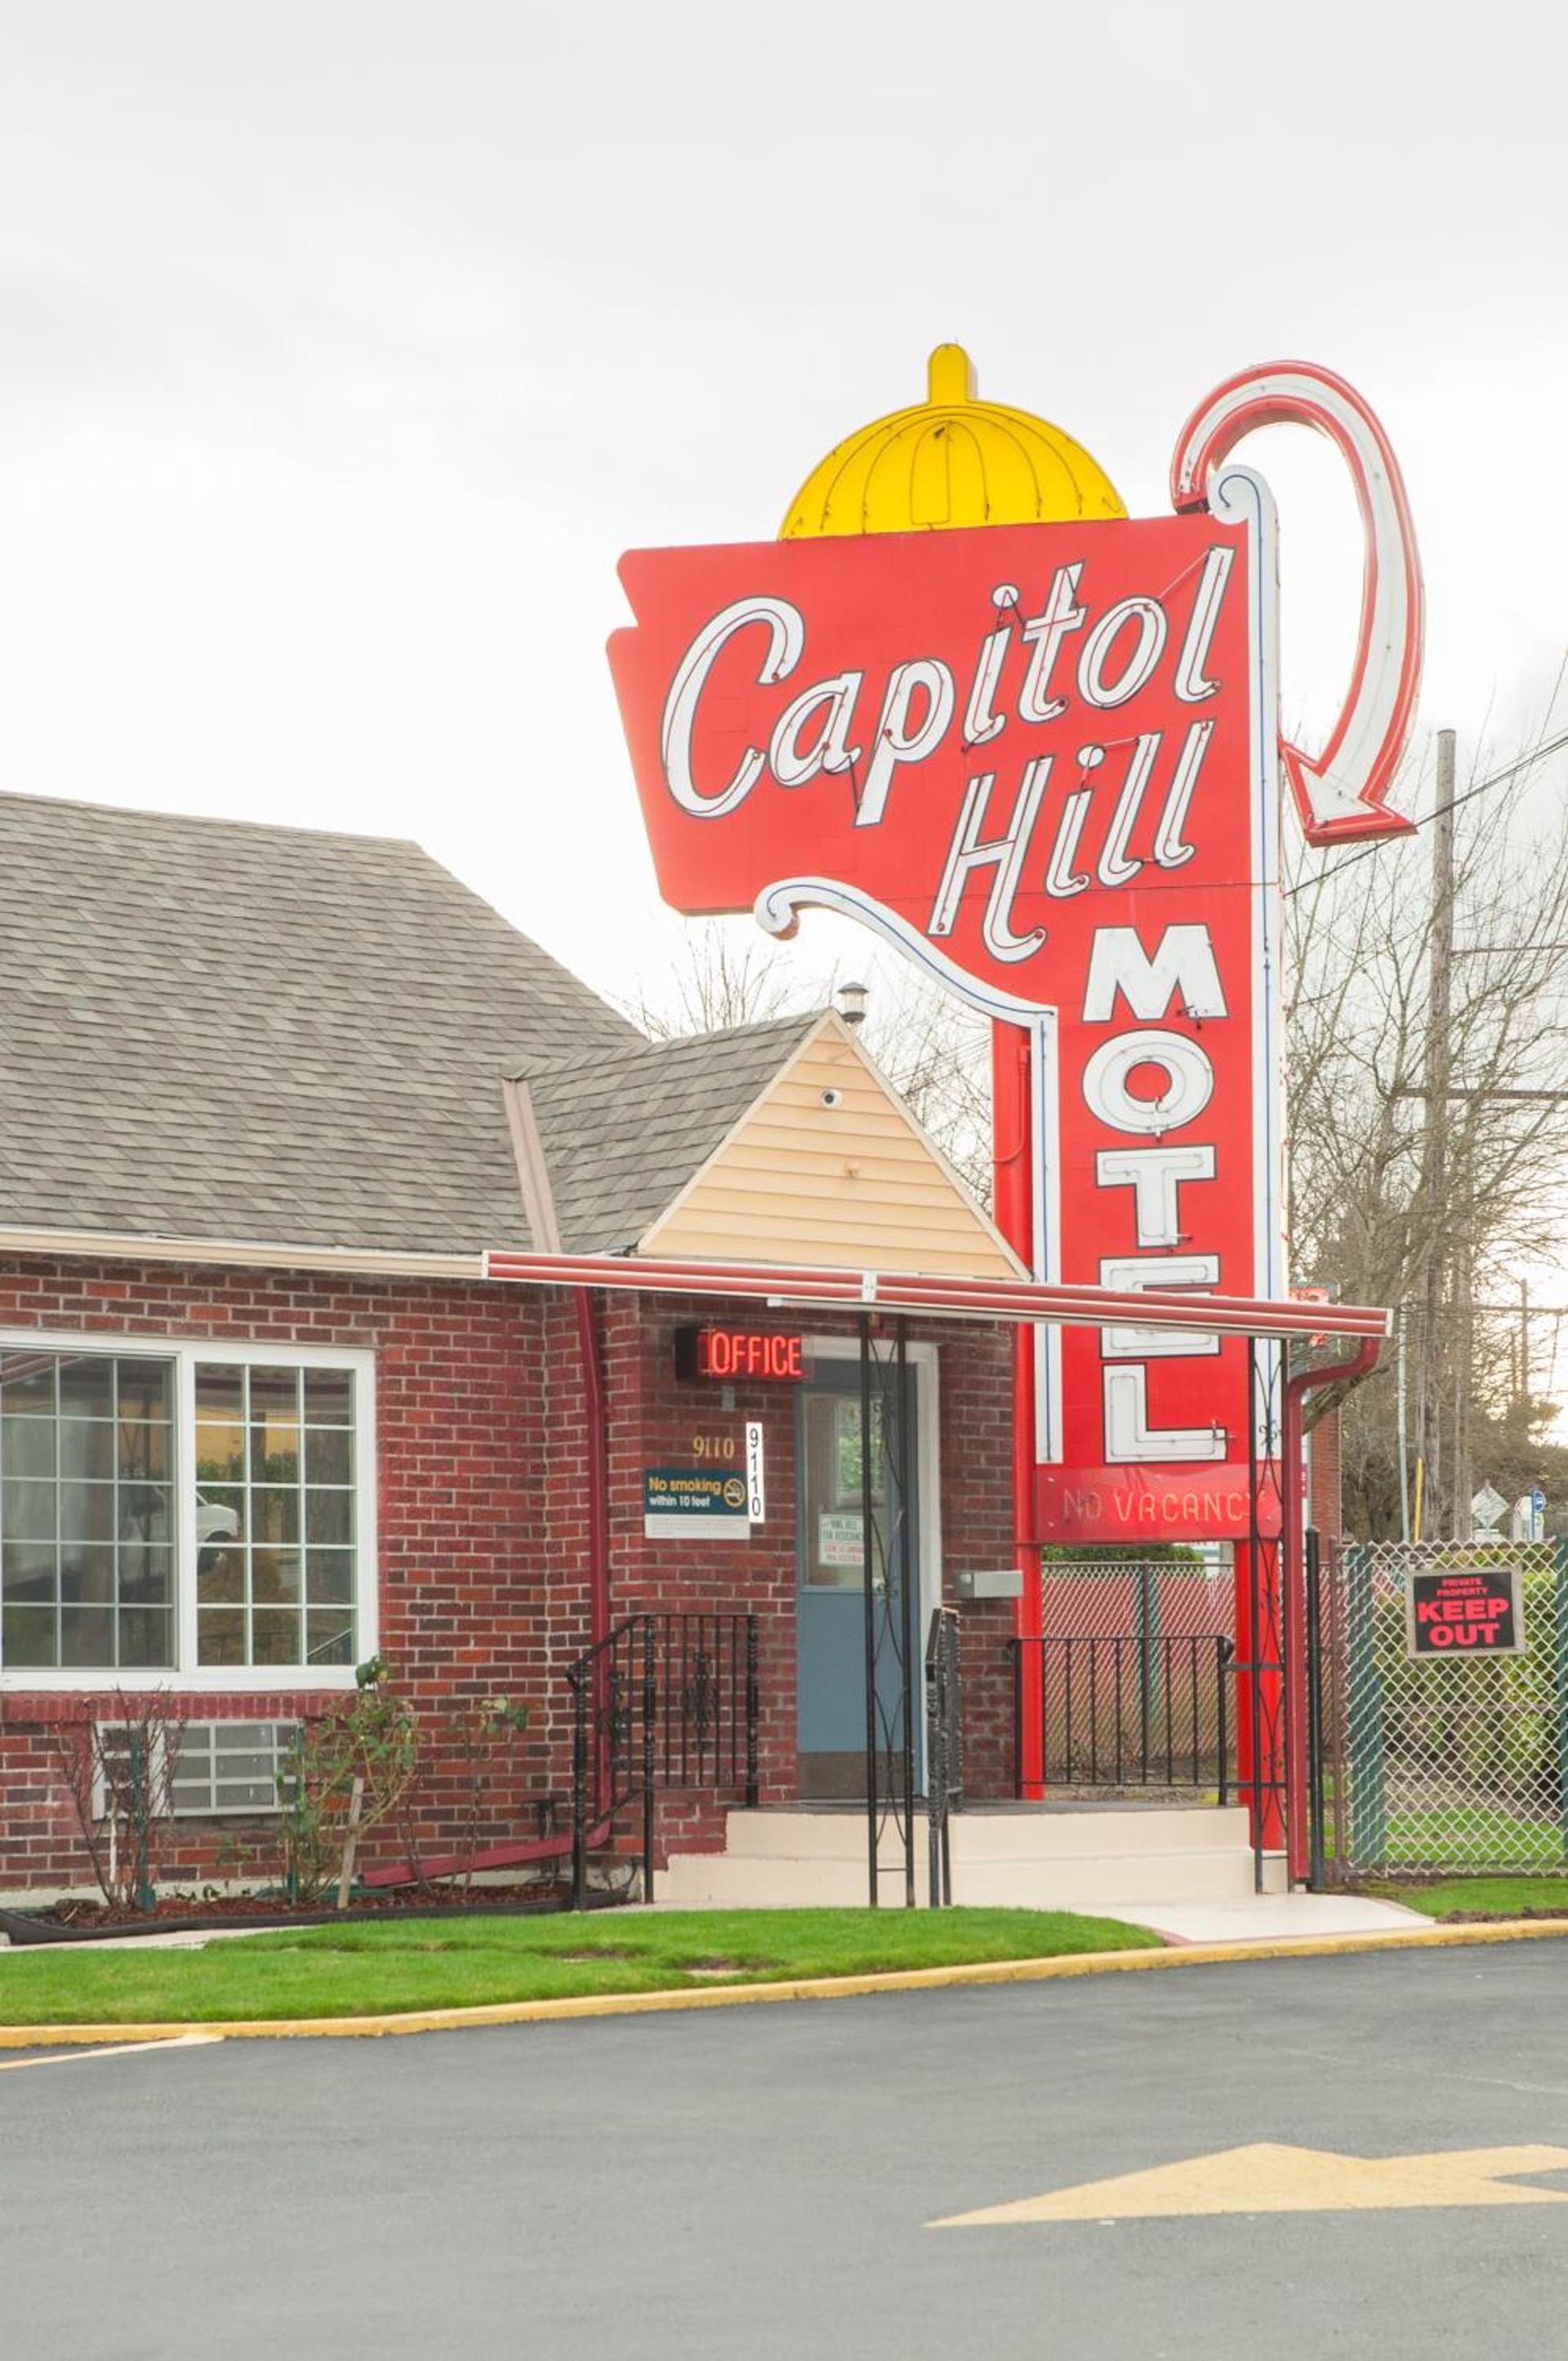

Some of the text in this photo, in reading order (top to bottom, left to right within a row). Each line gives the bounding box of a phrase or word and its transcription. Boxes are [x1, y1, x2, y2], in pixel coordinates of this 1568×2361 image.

[662, 545, 1236, 827] Capitol
[928, 719, 1216, 963] Hill
[1082, 924, 1228, 1465] MOTEL
[711, 1332, 803, 1376] OFFICE
[693, 1435, 735, 1459] 9110
[648, 1477, 722, 1495] No smoking
[750, 1428, 761, 1517] 9110
[648, 1495, 711, 1508] within 10 feet
[1063, 1488, 1102, 1521] NO
[1417, 1597, 1510, 1623] KEEP
[1428, 1623, 1500, 1647] OUT
